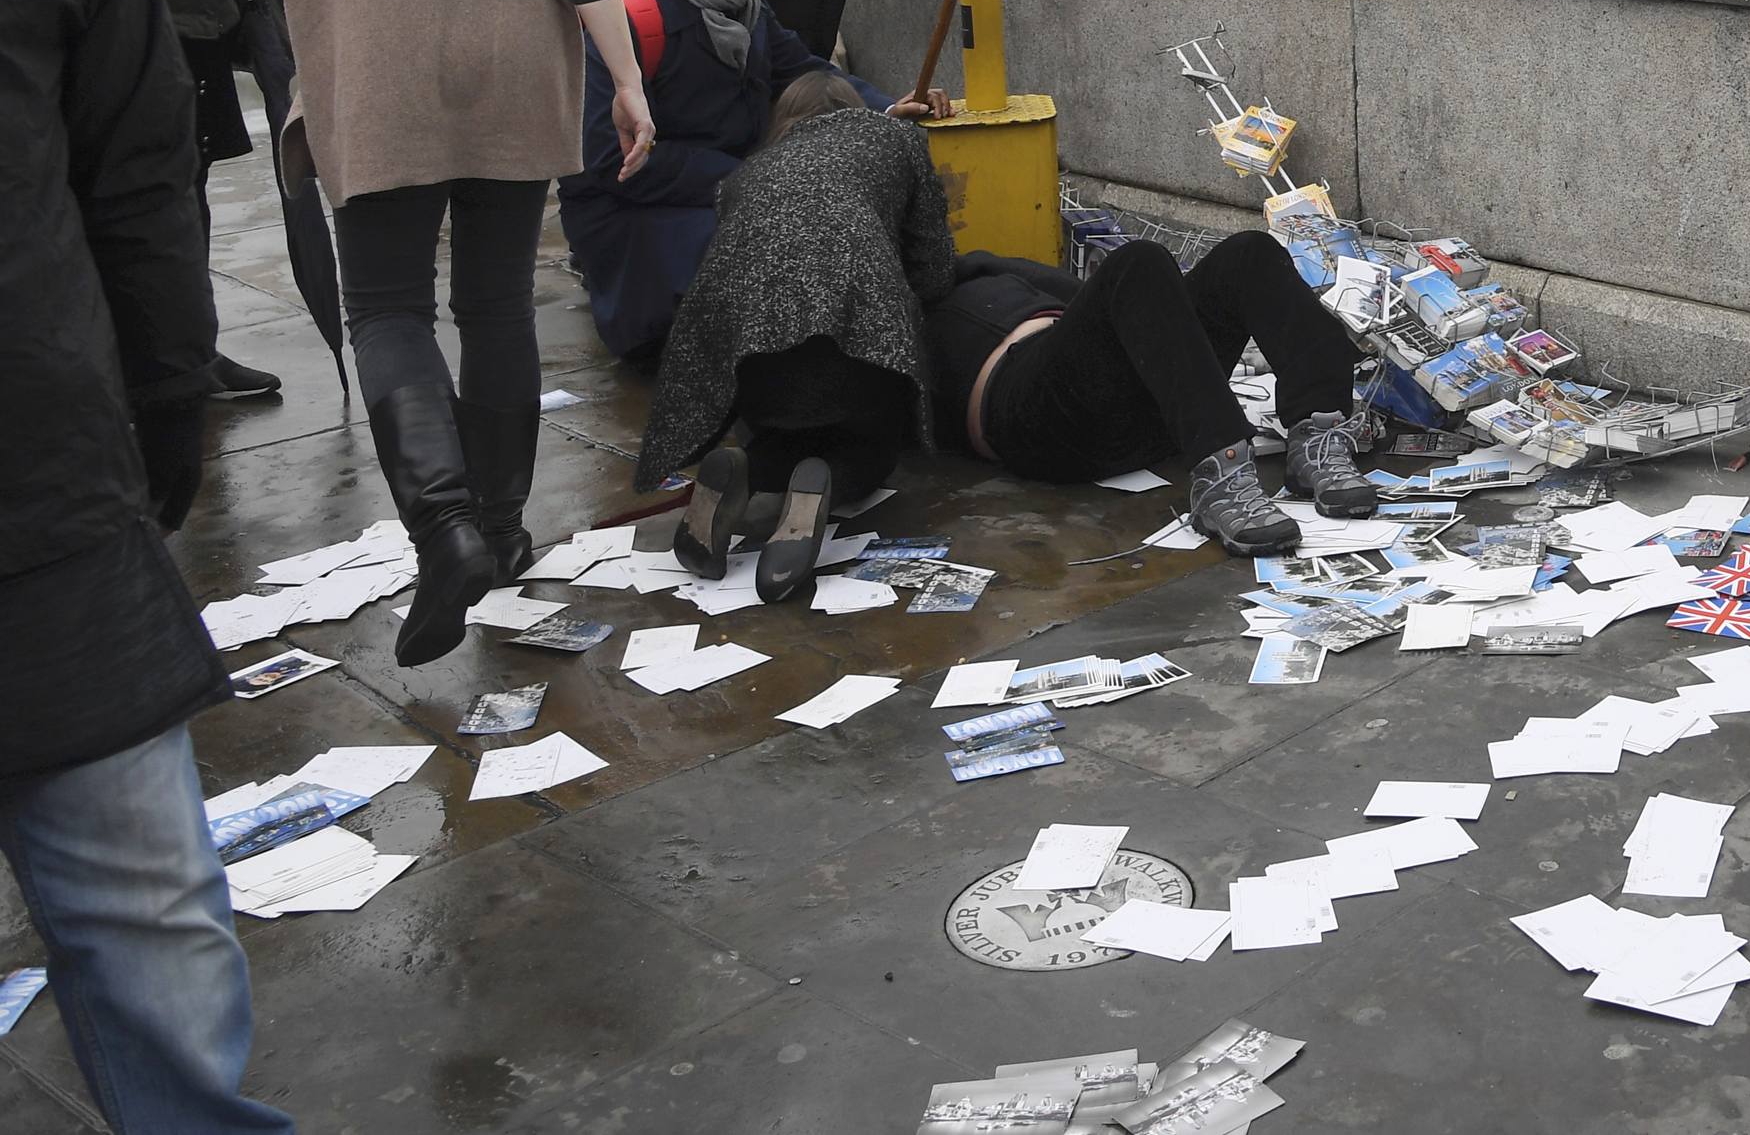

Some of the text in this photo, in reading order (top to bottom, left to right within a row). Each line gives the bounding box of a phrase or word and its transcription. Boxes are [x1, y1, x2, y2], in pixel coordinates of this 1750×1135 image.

[1501, 376, 1538, 394] LONDON
[950, 704, 1048, 739] LONDON
[959, 748, 1060, 780] LONDON
[209, 790, 319, 844] ONDON
[969, 864, 1024, 902] JUB
[956, 906, 1022, 963] SILVER
